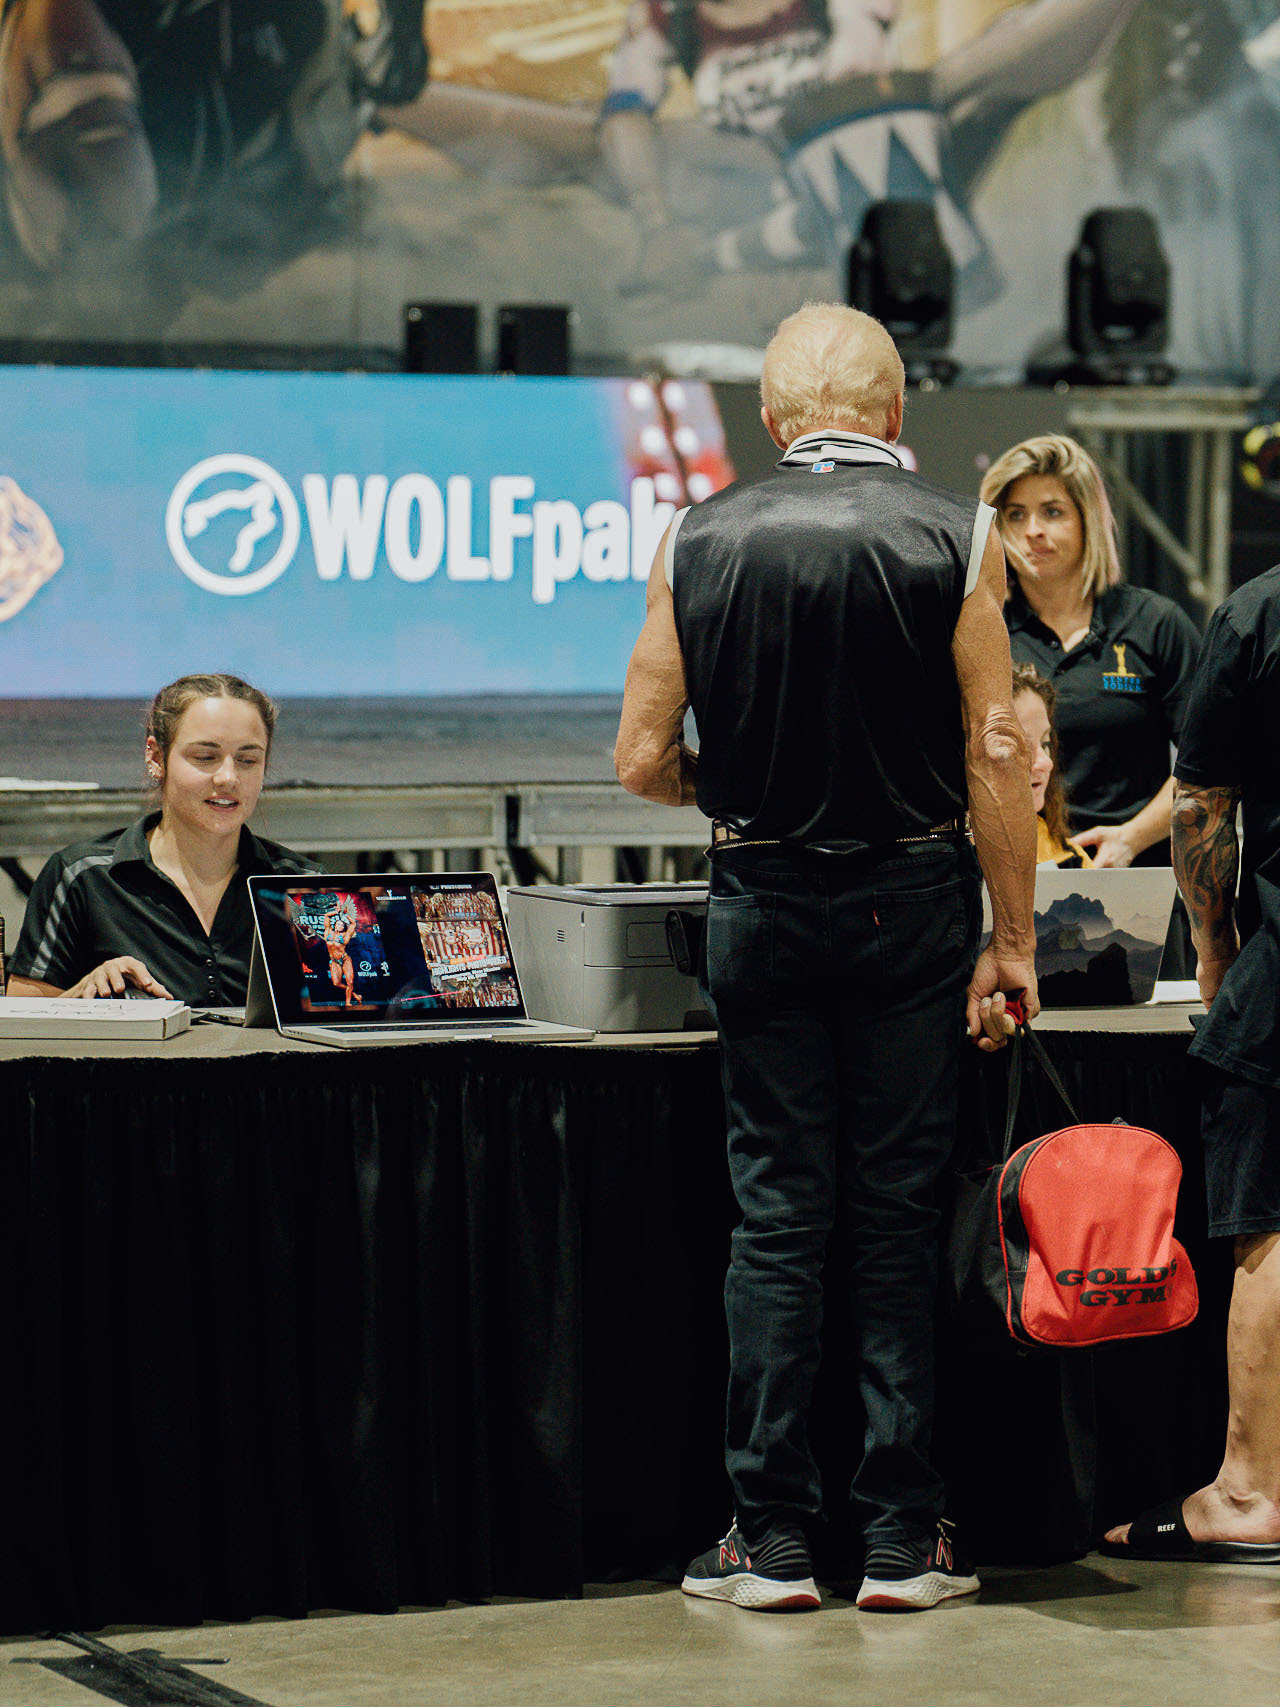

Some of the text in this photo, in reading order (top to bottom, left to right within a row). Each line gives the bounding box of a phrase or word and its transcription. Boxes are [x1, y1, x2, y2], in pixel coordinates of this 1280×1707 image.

[302, 474, 677, 604] WOLFpak
[1080, 1285, 1167, 1307] GYM
[1157, 1523, 1176, 1532] REEF
